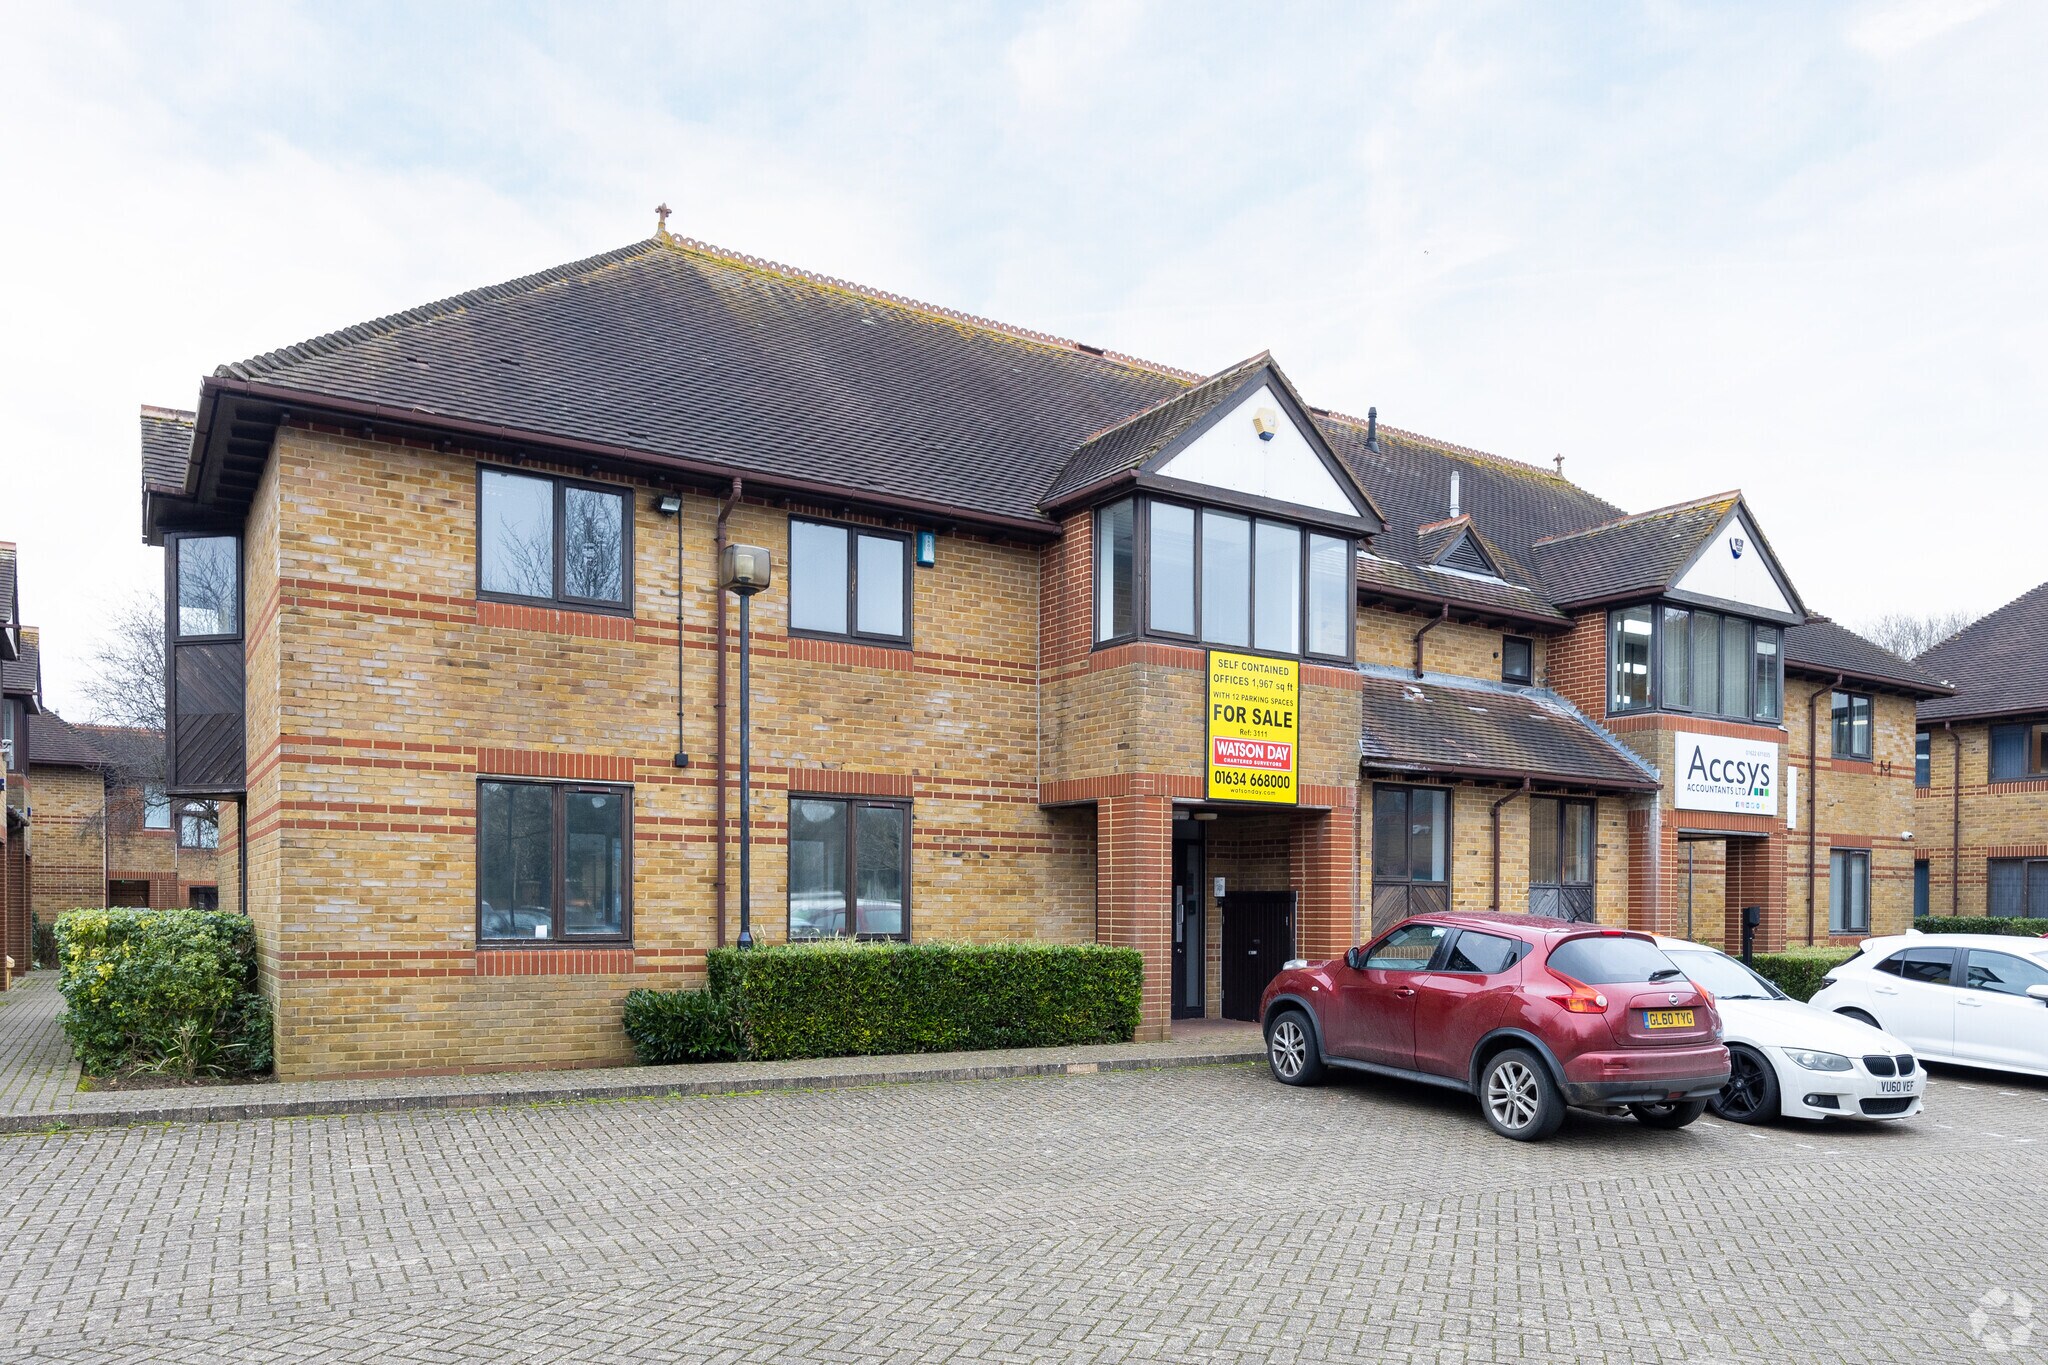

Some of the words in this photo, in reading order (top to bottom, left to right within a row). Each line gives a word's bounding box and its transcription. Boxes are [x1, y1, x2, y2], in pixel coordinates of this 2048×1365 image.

[1218, 659, 1239, 669] SELF
[1241, 662, 1289, 676] CONTAINED
[1213, 674, 1249, 686] OFFICES
[1252, 679, 1273, 690] 1,967
[1275, 683, 1285, 692] sq
[1287, 683, 1293, 691] ft
[1213, 691, 1230, 699] WITH
[1241, 694, 1269, 704] PARKING
[1271, 698, 1293, 707] SPACES
[1213, 704, 1246, 724] FOR
[1252, 708, 1292, 728] SALE
[1216, 740, 1264, 759] WATSON
[1267, 745, 1289, 761] DAY
[1687, 745, 1770, 796] Accsys
[1215, 770, 1246, 785] 01634
[1250, 773, 1290, 789] 668000
[1230, 788, 1276, 796] watsonday.com
[1686, 783, 1734, 795] ACCOUNTANTS
[1735, 787, 1747, 796] LTD
[1649, 1012, 1673, 1026] GL60
[1675, 1012, 1692, 1025] TYG
[1881, 1081, 1901, 1092] VU60
